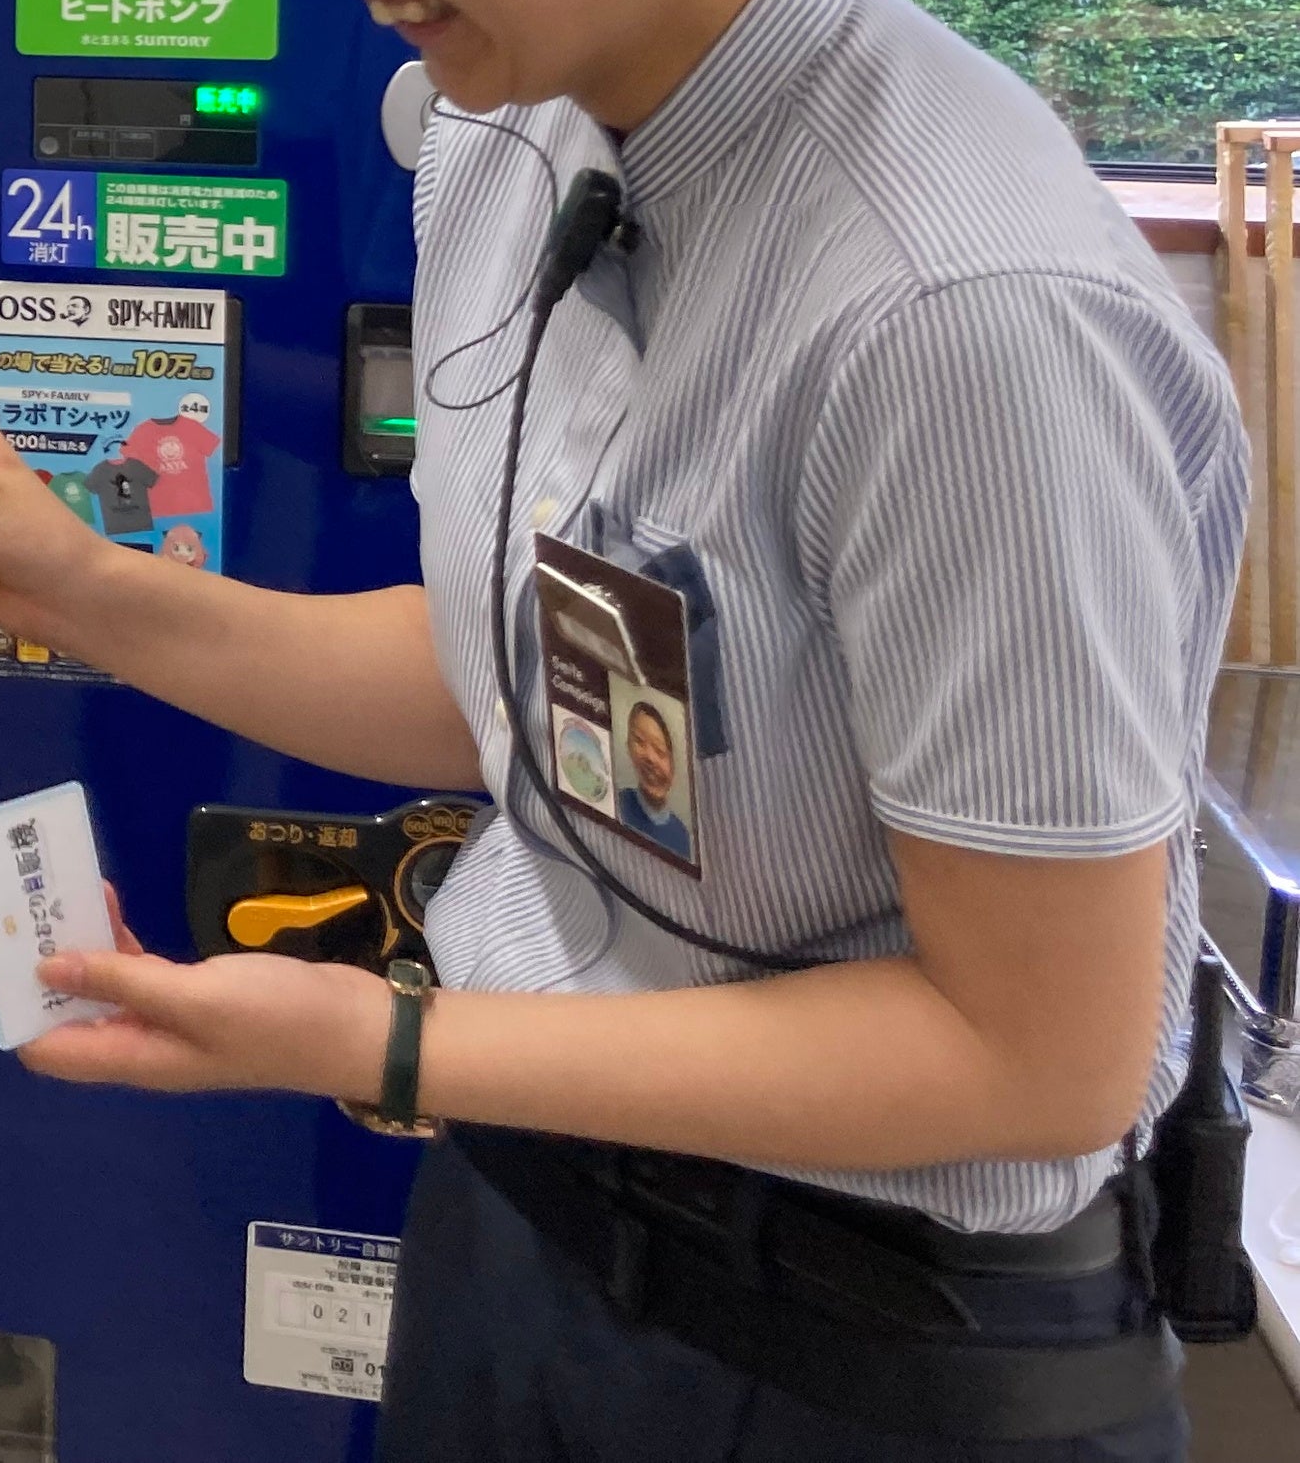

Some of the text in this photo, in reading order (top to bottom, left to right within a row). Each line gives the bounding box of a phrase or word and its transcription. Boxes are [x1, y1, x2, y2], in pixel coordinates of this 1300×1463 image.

[134, 34, 211, 48] SUNTORY
[196, 86, 258, 115] 販売中
[7, 176, 93, 241] 24h
[28, 242, 68, 264] 消灯
[105, 212, 277, 271] 販売中
